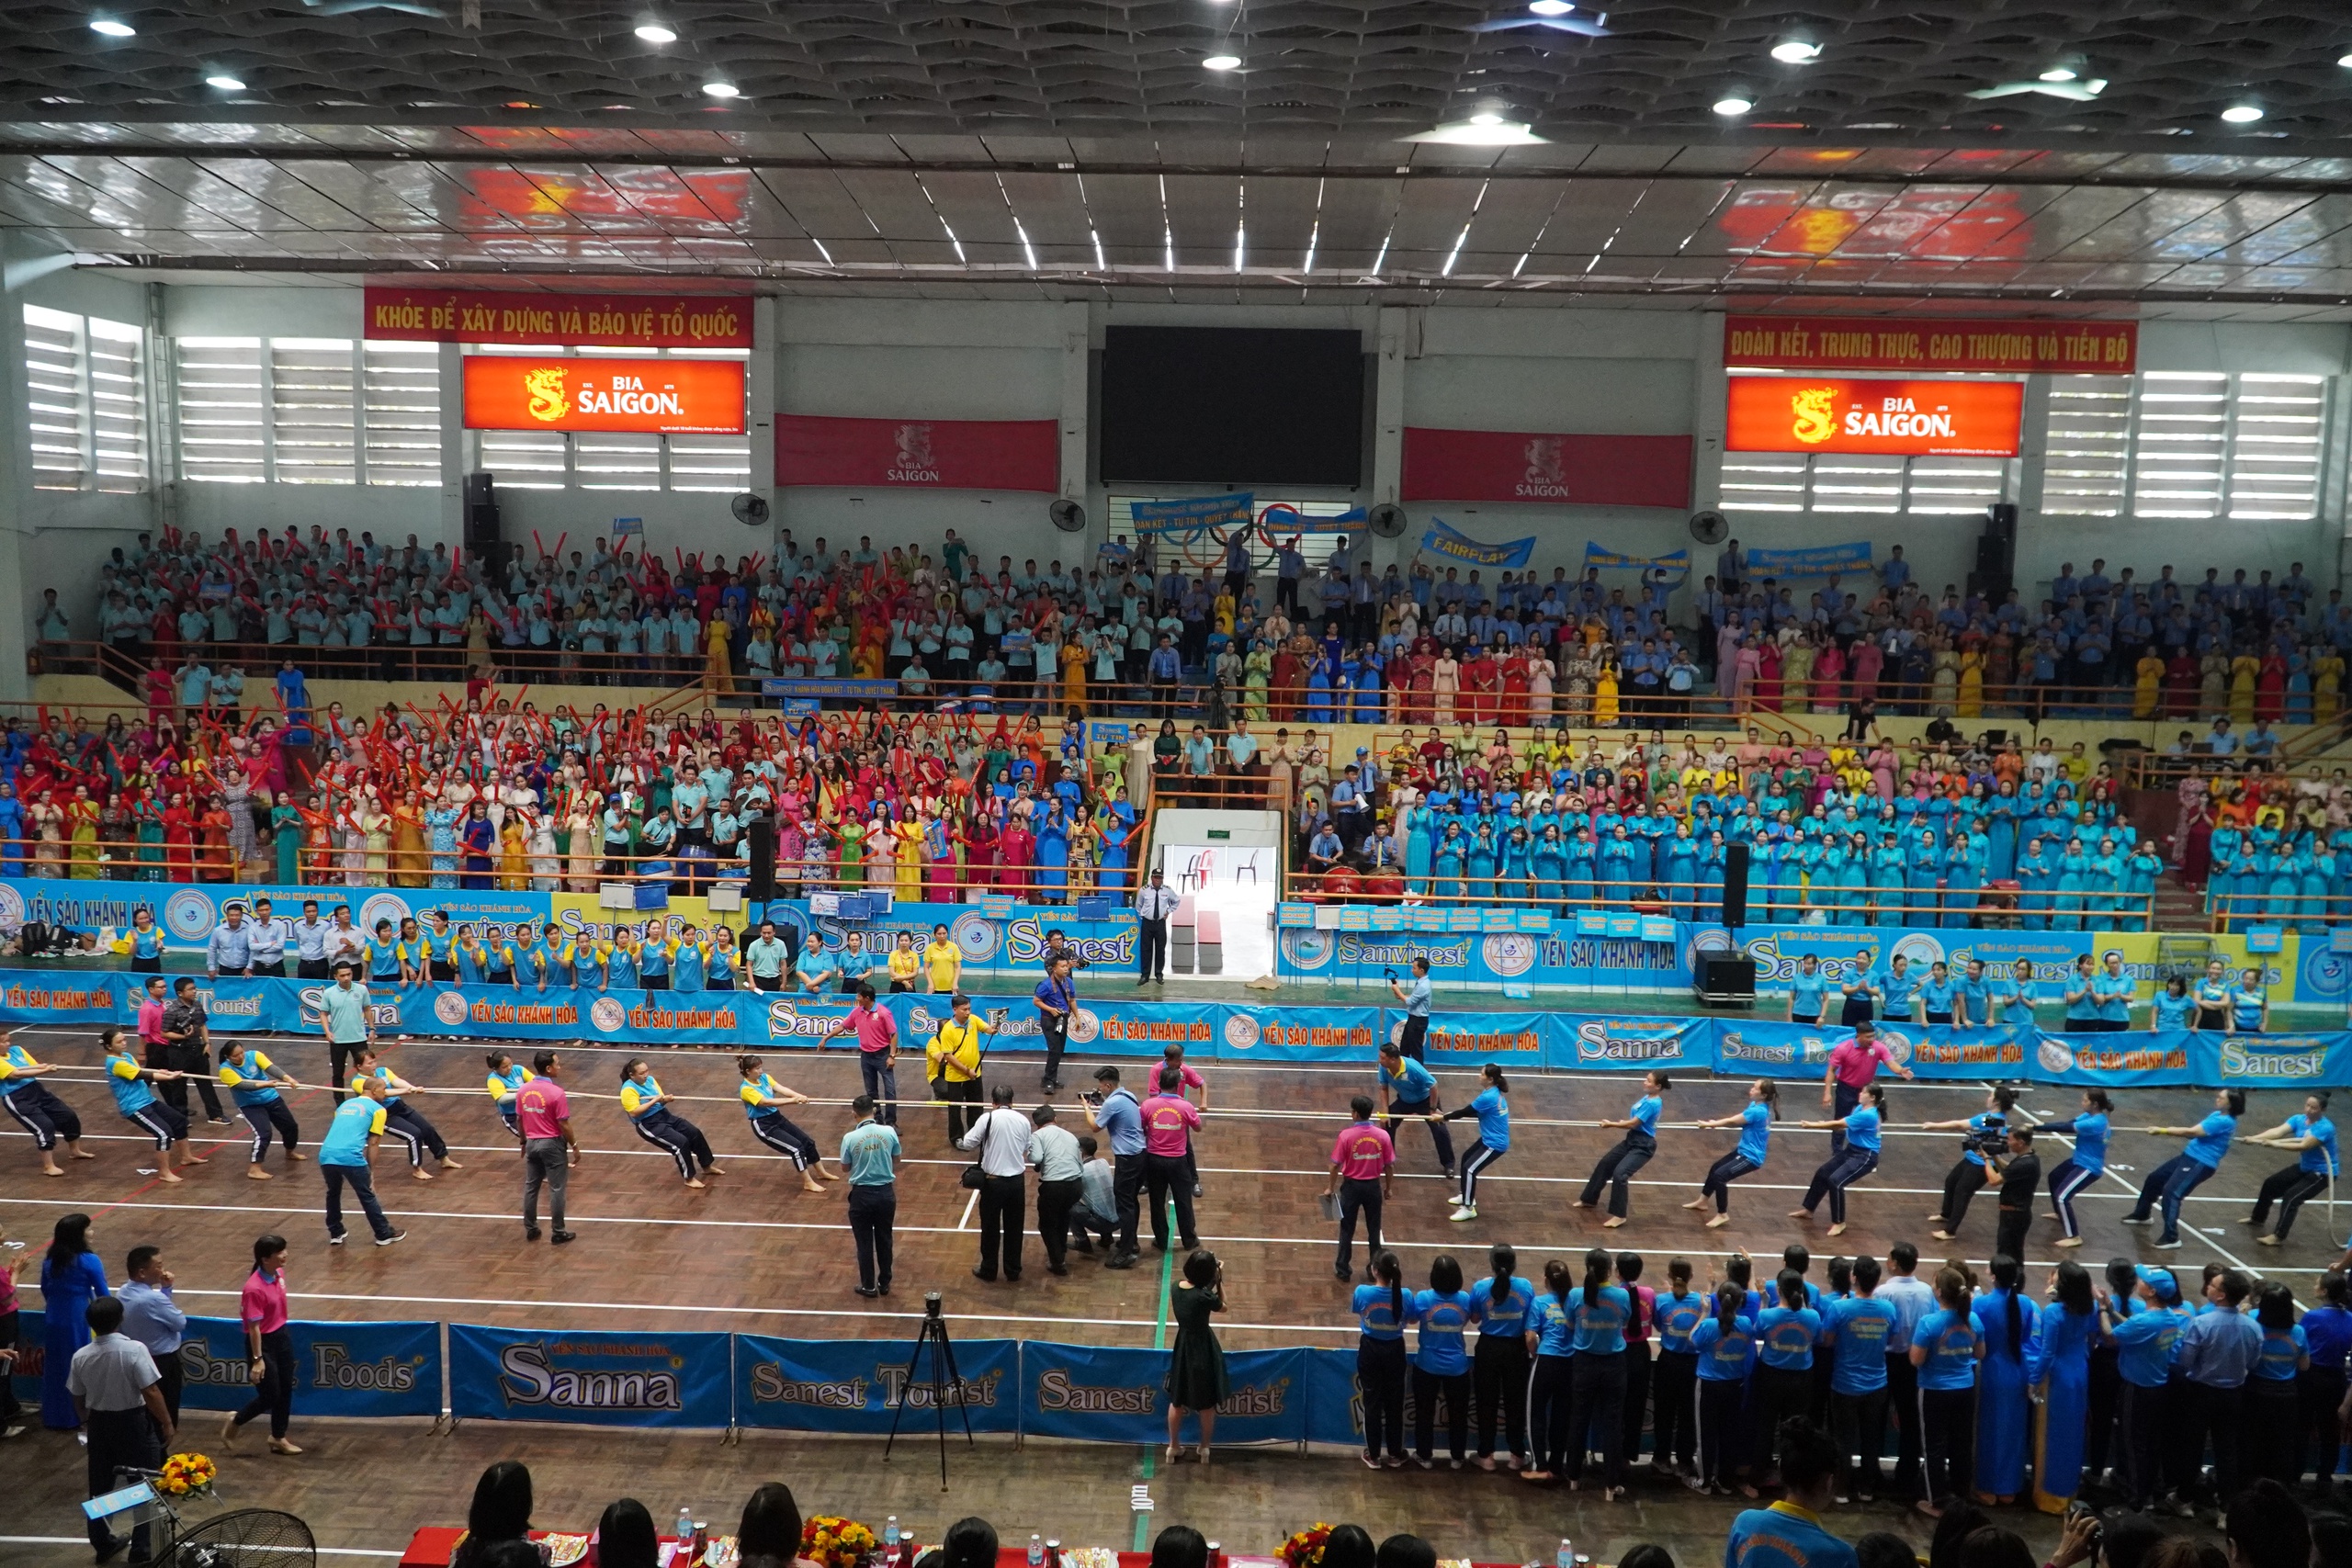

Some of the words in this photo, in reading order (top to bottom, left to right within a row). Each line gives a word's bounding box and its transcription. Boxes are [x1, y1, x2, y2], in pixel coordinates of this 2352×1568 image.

[376, 298, 424, 329] KHỎE
[431, 297, 458, 330] ĐỂ
[461, 303, 496, 332] XÂY
[503, 307, 553, 338] DỰNG
[559, 306, 582, 334] VÀ
[589, 304, 625, 335] BẢO
[631, 308, 654, 341] VỆ
[661, 302, 685, 336] TỔ
[689, 305, 738, 337] QUỐC
[1731, 325, 1775, 355] ĐOÀN
[1820, 333, 1872, 358] TRUNG
[1929, 334, 1962, 359] CAO
[1968, 333, 2032, 366] THƯỢNG
[2038, 330, 2058, 361] VÀ
[2064, 326, 2099, 362] TIẾN
[2105, 333, 2129, 367] BỘ
[613, 376, 644, 390] BIA
[1883, 397, 1917, 412] BIA
[888, 469, 939, 481] SAIGON
[1515, 484, 1569, 497] SAIGON
[1433, 536, 1508, 563] FAIRPLAY
[27, 888, 53, 925] YẾN
[56, 892, 81, 927] SÀO
[84, 894, 128, 928] KHÁNH
[252, 888, 271, 900] YẾN
[272, 890, 292, 901] SÀO
[293, 891, 325, 902] KHÁNH
[327, 892, 348, 903] HÒA
[440, 902, 458, 912] YẾN
[459, 903, 478, 912] SÀO
[480, 903, 512, 913] KHÁNH
[513, 904, 533, 914] HÒA
[915, 921, 933, 931] HÒA
[1041, 911, 1060, 921] YẾN
[1117, 912, 1138, 923] HÒA
[1541, 929, 1567, 967] YẾN
[1779, 931, 1800, 941] YẾN
[1801, 931, 1821, 942] SÀO
[1821, 932, 1857, 942] KHÁNH
[1857, 932, 1880, 942] HÒA
[6, 983, 28, 1008] YẾN
[29, 986, 51, 1009] SÀO
[51, 987, 90, 1010] KHÁNH
[90, 987, 114, 1009] HÒA
[195, 988, 261, 1015] Tourist
[470, 997, 492, 1023] YẾN
[493, 999, 515, 1024] SÀO
[516, 1001, 553, 1024] KHÁNH
[555, 1001, 579, 1025] HÒA
[628, 1003, 650, 1029] YẾN
[651, 1005, 673, 1029] SÀO
[675, 1006, 713, 1030] KHÁNH
[715, 1005, 738, 1030] HÒA
[1102, 1014, 1124, 1040] YẾN
[1126, 1017, 1148, 1041] SÀO
[1150, 1018, 1187, 1041] KHÁNH
[1189, 1018, 1212, 1041] HÒA
[1263, 1020, 1285, 1045] YẾN
[1287, 1022, 1308, 1046] SÀO
[1311, 1023, 1349, 1046] KHÁNH
[1351, 1023, 1373, 1046] HÒA
[1430, 1025, 1452, 1050] YẾN
[1453, 1028, 1476, 1051] SÀO
[1477, 1029, 1514, 1051] KHÁNH
[1577, 1020, 1683, 1063] Sanna
[1723, 1032, 1795, 1065] Sanest
[1915, 1037, 1937, 1063] YẾN
[1938, 1041, 1961, 1064] SÀO
[1962, 1040, 1999, 1064] KHÁNH
[2001, 1041, 2024, 1063] HÒA
[2075, 1043, 2098, 1070] YẾN
[2124, 1046, 2164, 1071] KHÁNH
[2221, 1038, 2327, 1079] Sanest
[549, 1340, 574, 1356] YẾN
[577, 1342, 601, 1356] SÀO
[603, 1342, 645, 1357] KHÁNH
[646, 1343, 671, 1357] HÒA
[311, 1343, 414, 1392] Foods
[499, 1338, 683, 1411] Sanna
[752, 1361, 869, 1408] Sanest
[876, 1362, 1000, 1408] Tourist
[1038, 1369, 1157, 1414] Sanest
[1163, 1372, 1285, 1416] urist
[1131, 1484, 1155, 1512] 10m
